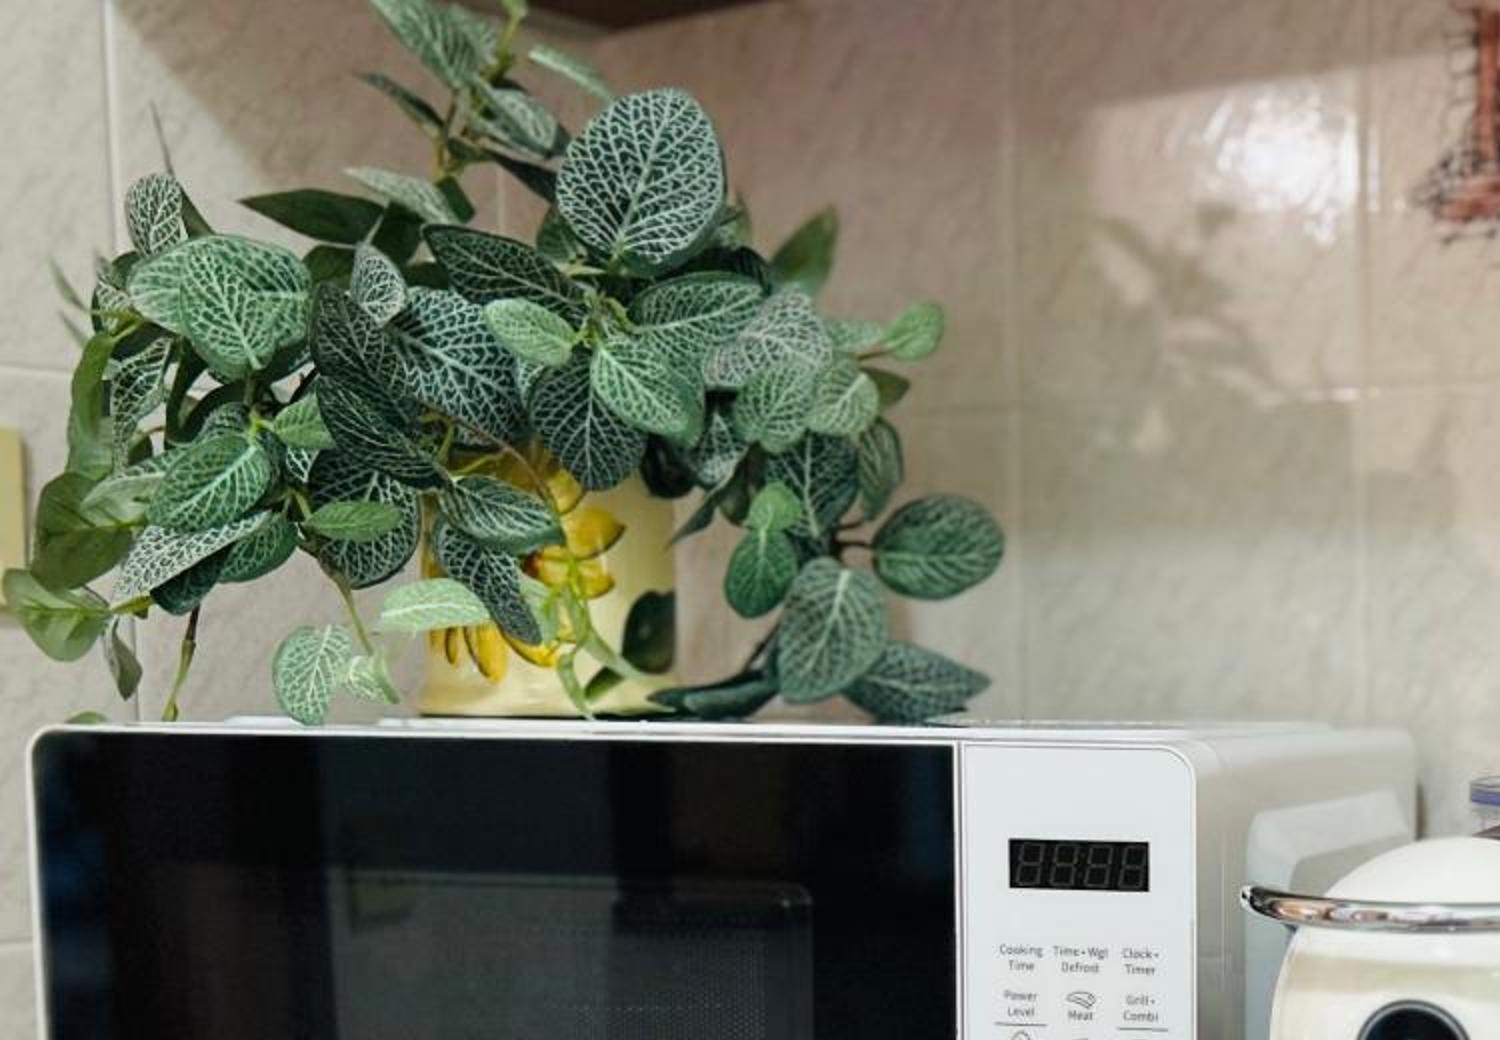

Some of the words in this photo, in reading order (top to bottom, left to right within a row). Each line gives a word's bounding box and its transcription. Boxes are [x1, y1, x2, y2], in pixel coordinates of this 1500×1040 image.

[1000, 944, 1044, 958] Cooking
[1009, 960, 1035, 971] Time
[1125, 964, 1156, 975] Timer
[1004, 989, 1037, 1001] Power
[1008, 1008, 1035, 1017] Level
